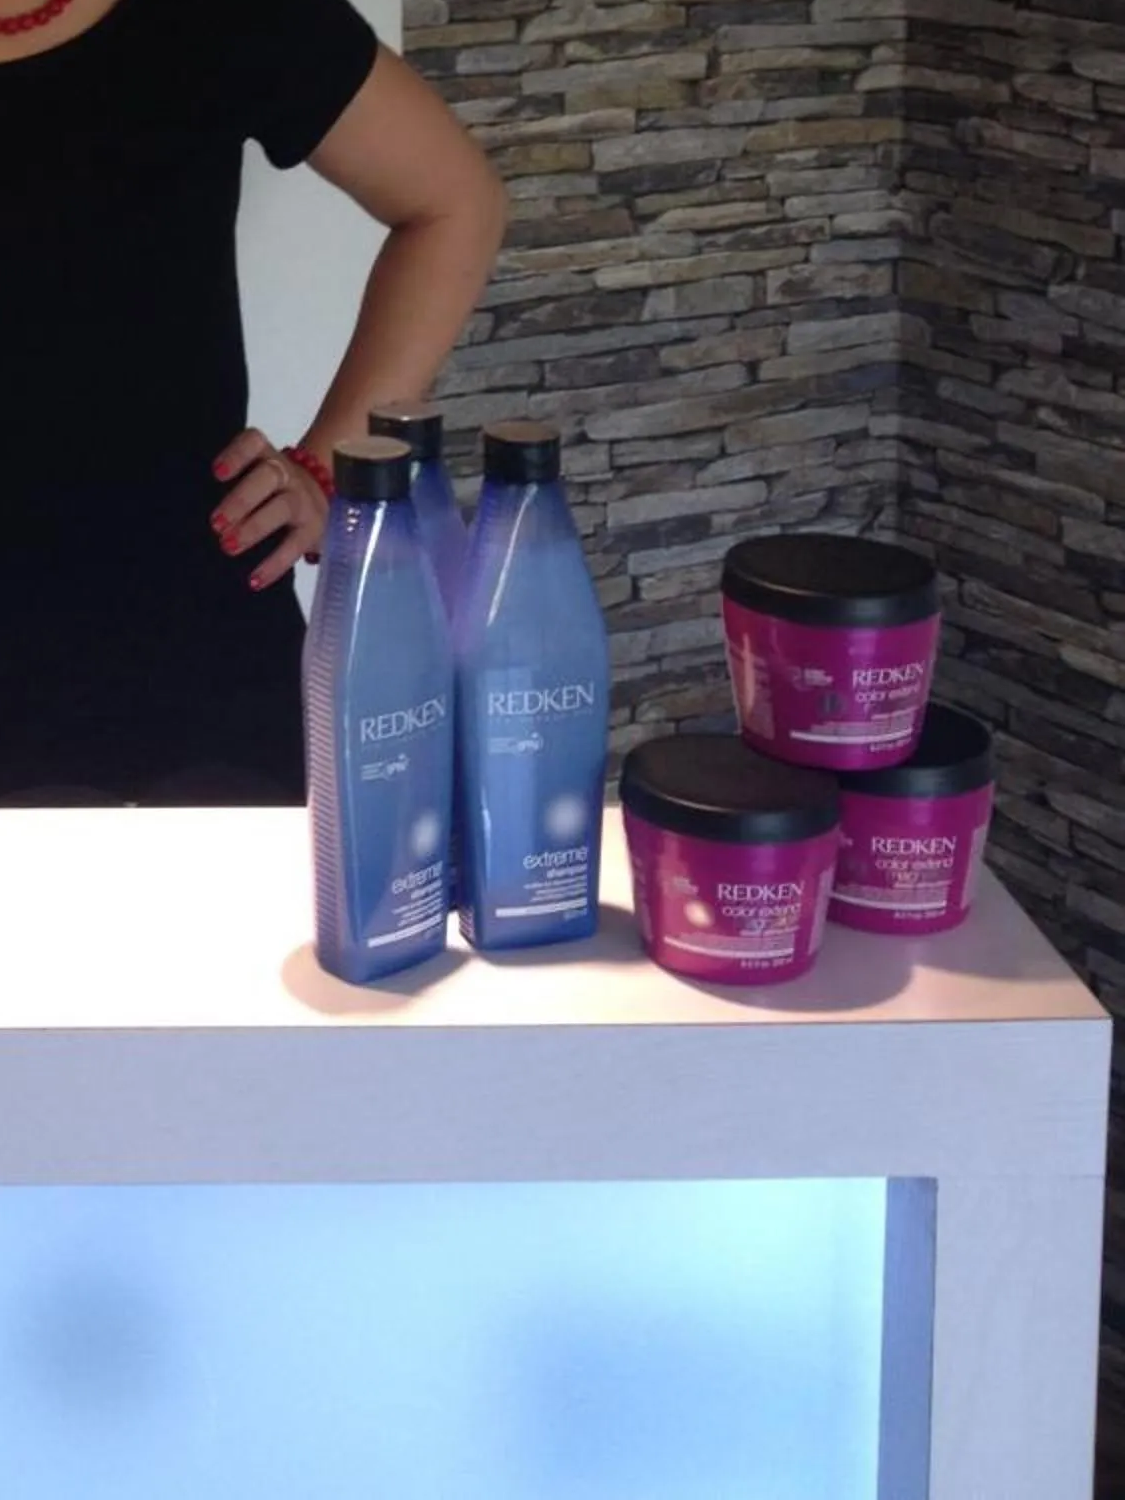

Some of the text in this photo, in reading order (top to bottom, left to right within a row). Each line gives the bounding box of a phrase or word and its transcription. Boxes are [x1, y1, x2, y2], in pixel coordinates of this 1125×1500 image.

[852, 660, 925, 689] REDKEN
[488, 682, 594, 716] REDKEN
[360, 694, 446, 744] REDKEN
[523, 846, 588, 870] extreme
[870, 835, 957, 855] REDKEN
[391, 860, 444, 895] extreme
[716, 880, 805, 902] REDKEN
